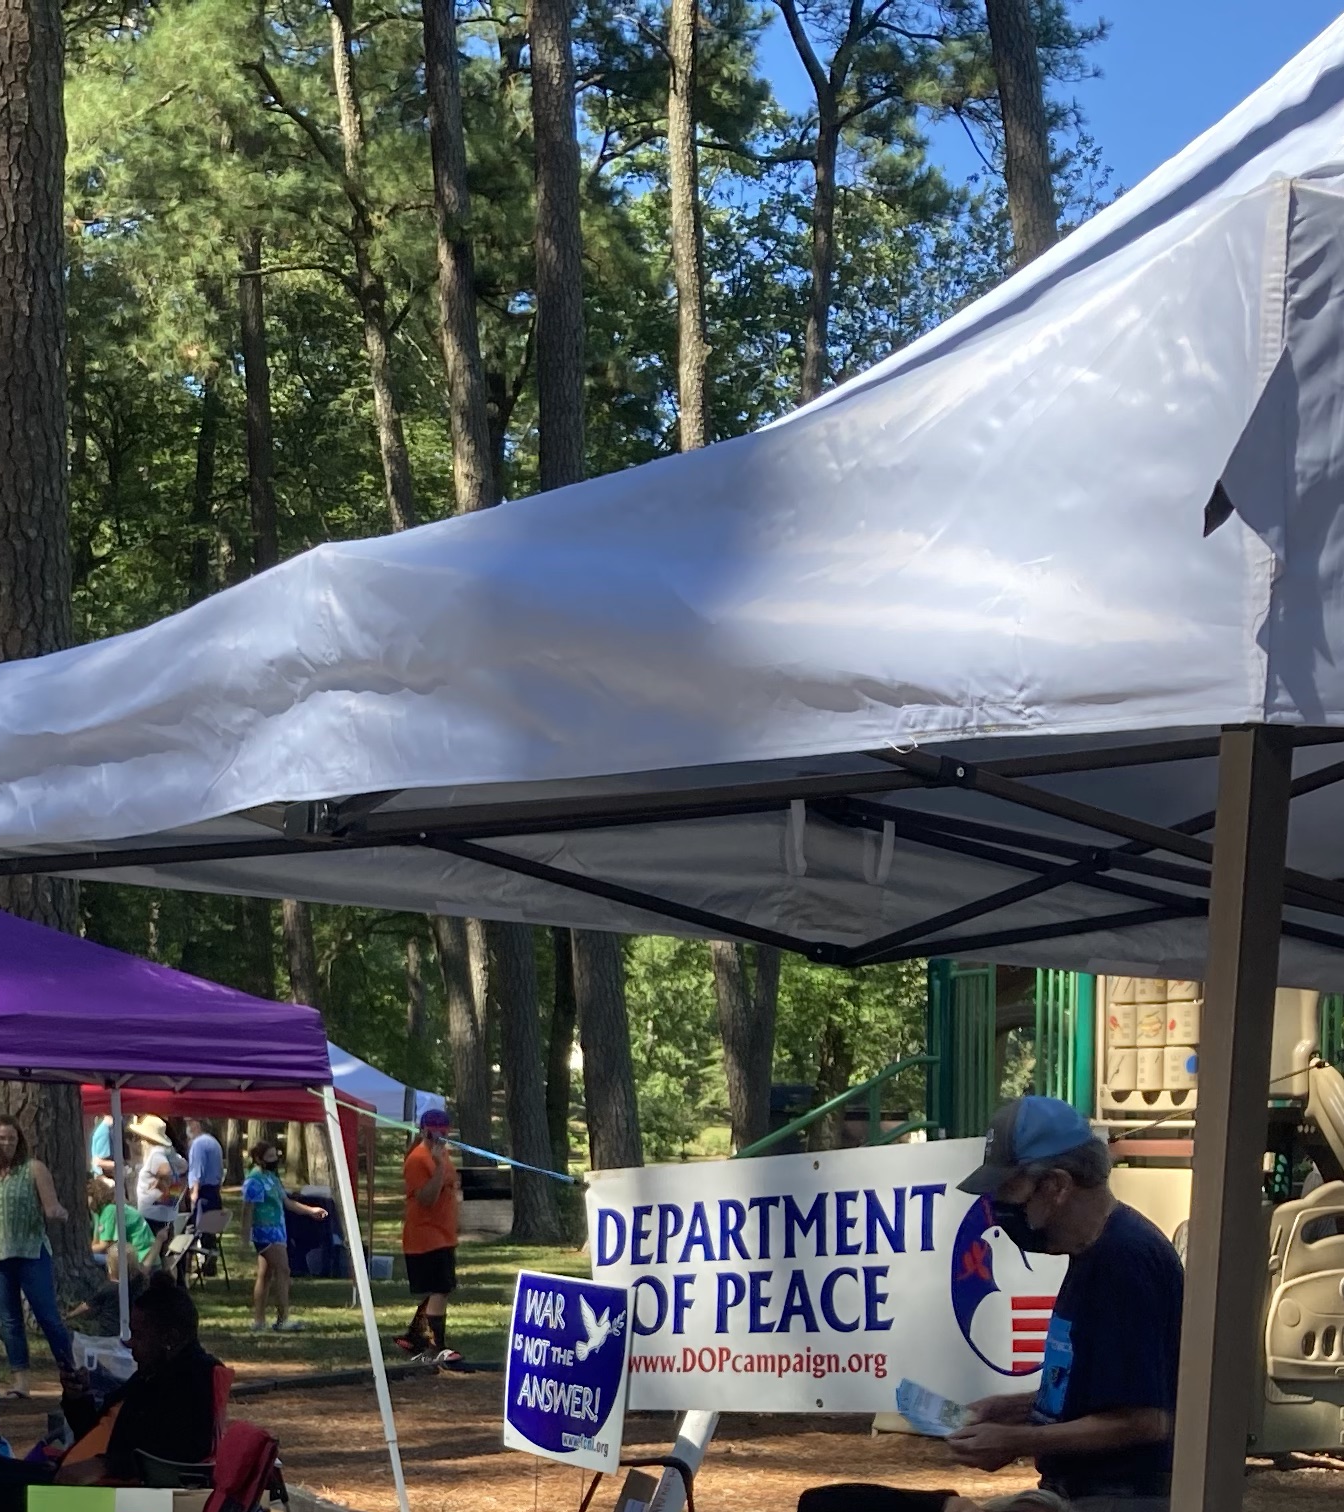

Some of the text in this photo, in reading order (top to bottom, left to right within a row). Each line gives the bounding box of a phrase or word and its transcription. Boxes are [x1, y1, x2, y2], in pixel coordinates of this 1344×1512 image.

[596, 1182, 947, 1268] DEPARTMENT
[524, 1288, 566, 1330] WAR
[632, 1265, 894, 1335] OF PEACE
[513, 1333, 575, 1367] IS NOT THE
[628, 1346, 888, 1379] www.DOPcampaign.org
[517, 1372, 601, 1423] ANSWER!
